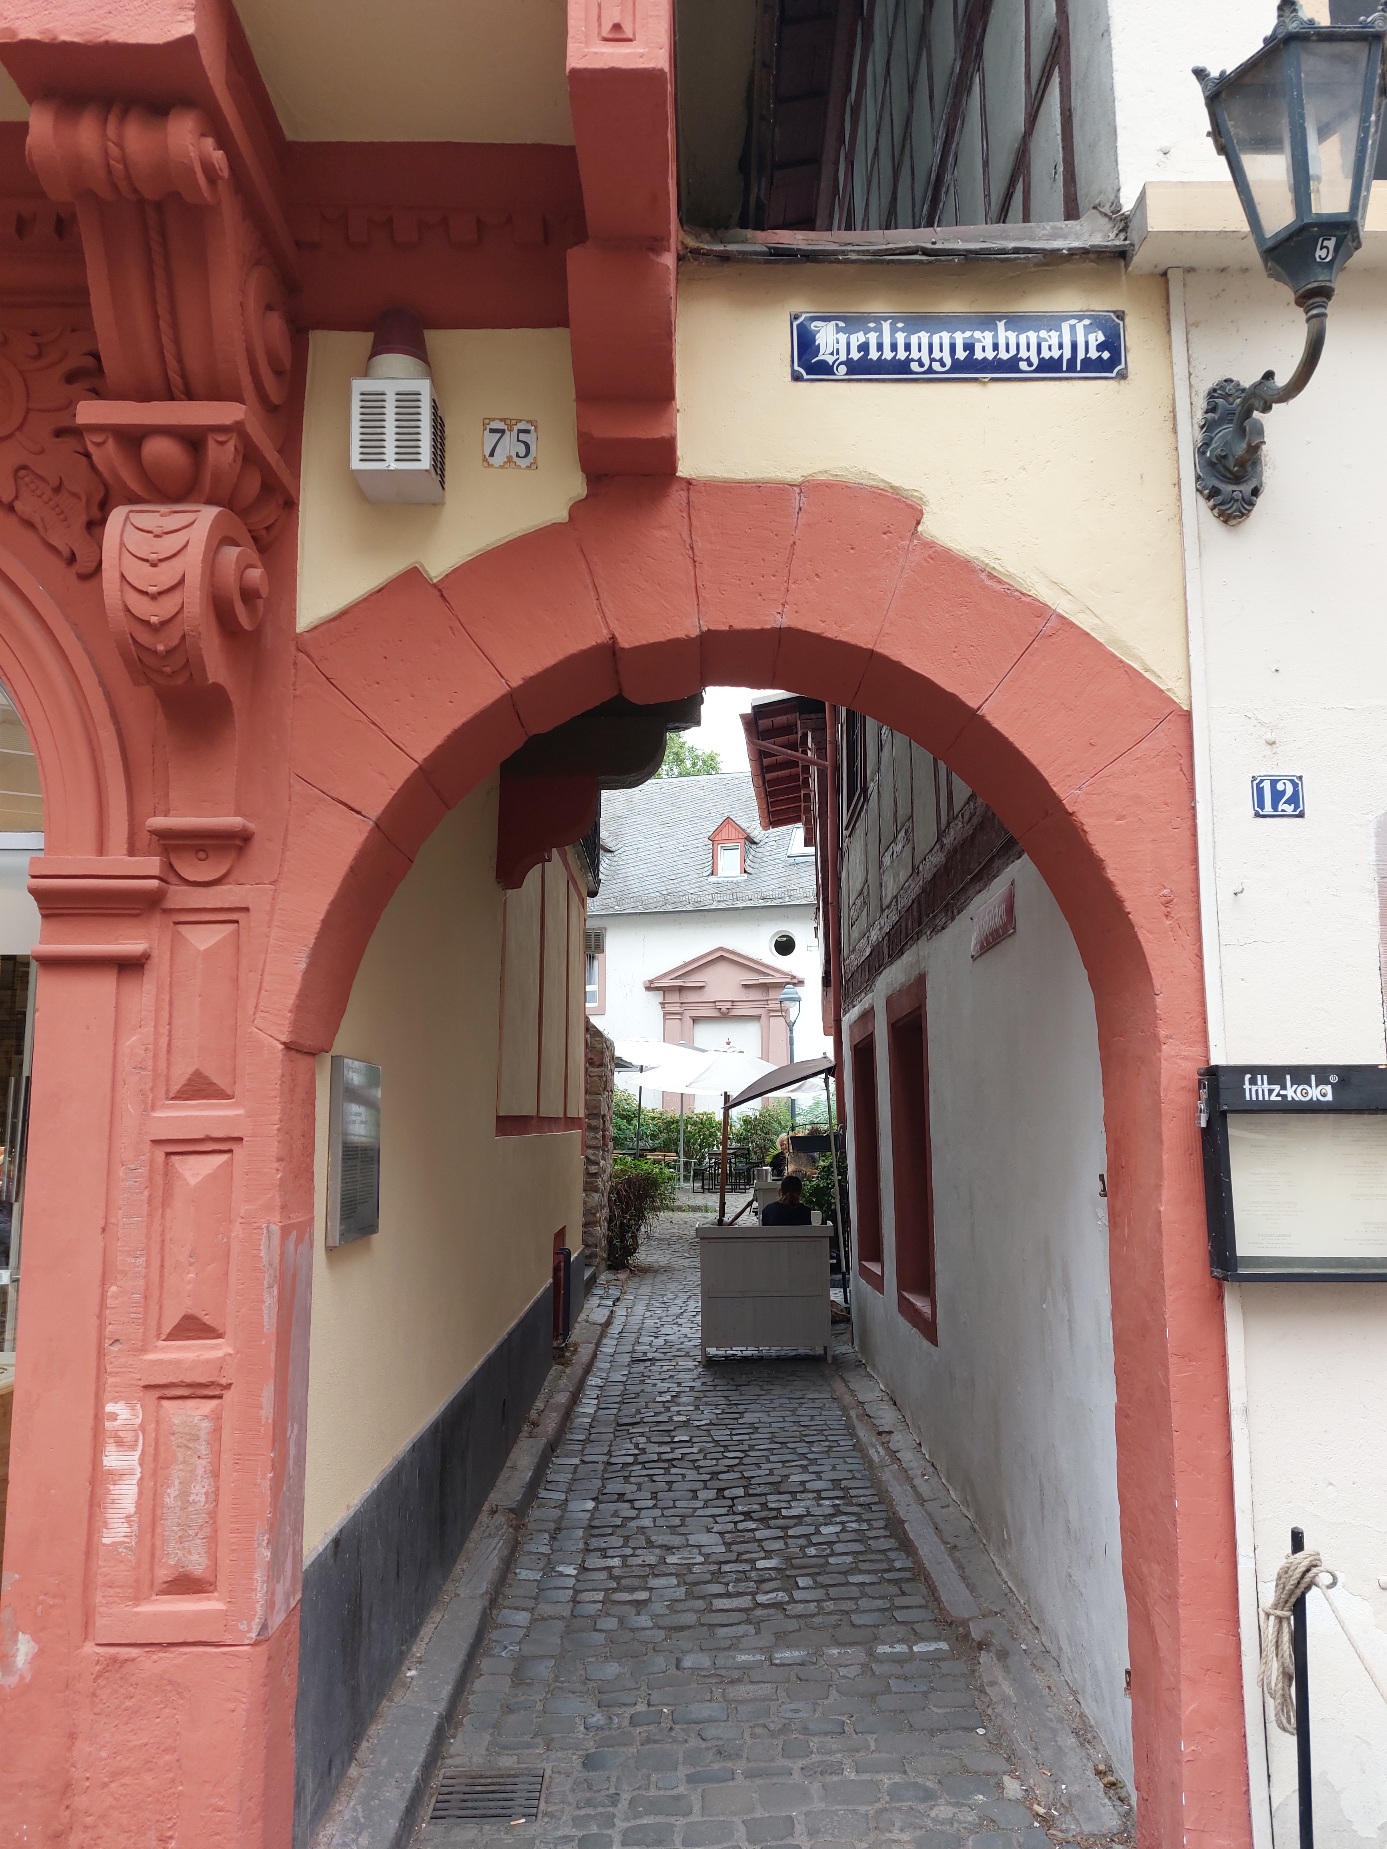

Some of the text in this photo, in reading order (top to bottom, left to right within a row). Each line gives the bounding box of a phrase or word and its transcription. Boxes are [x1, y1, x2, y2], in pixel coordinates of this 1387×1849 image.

[1318, 237, 1332, 260] 5
[487, 428, 532, 459] 75
[1259, 779, 1295, 812] 12
[1243, 1074, 1332, 1101] fritz-kola
